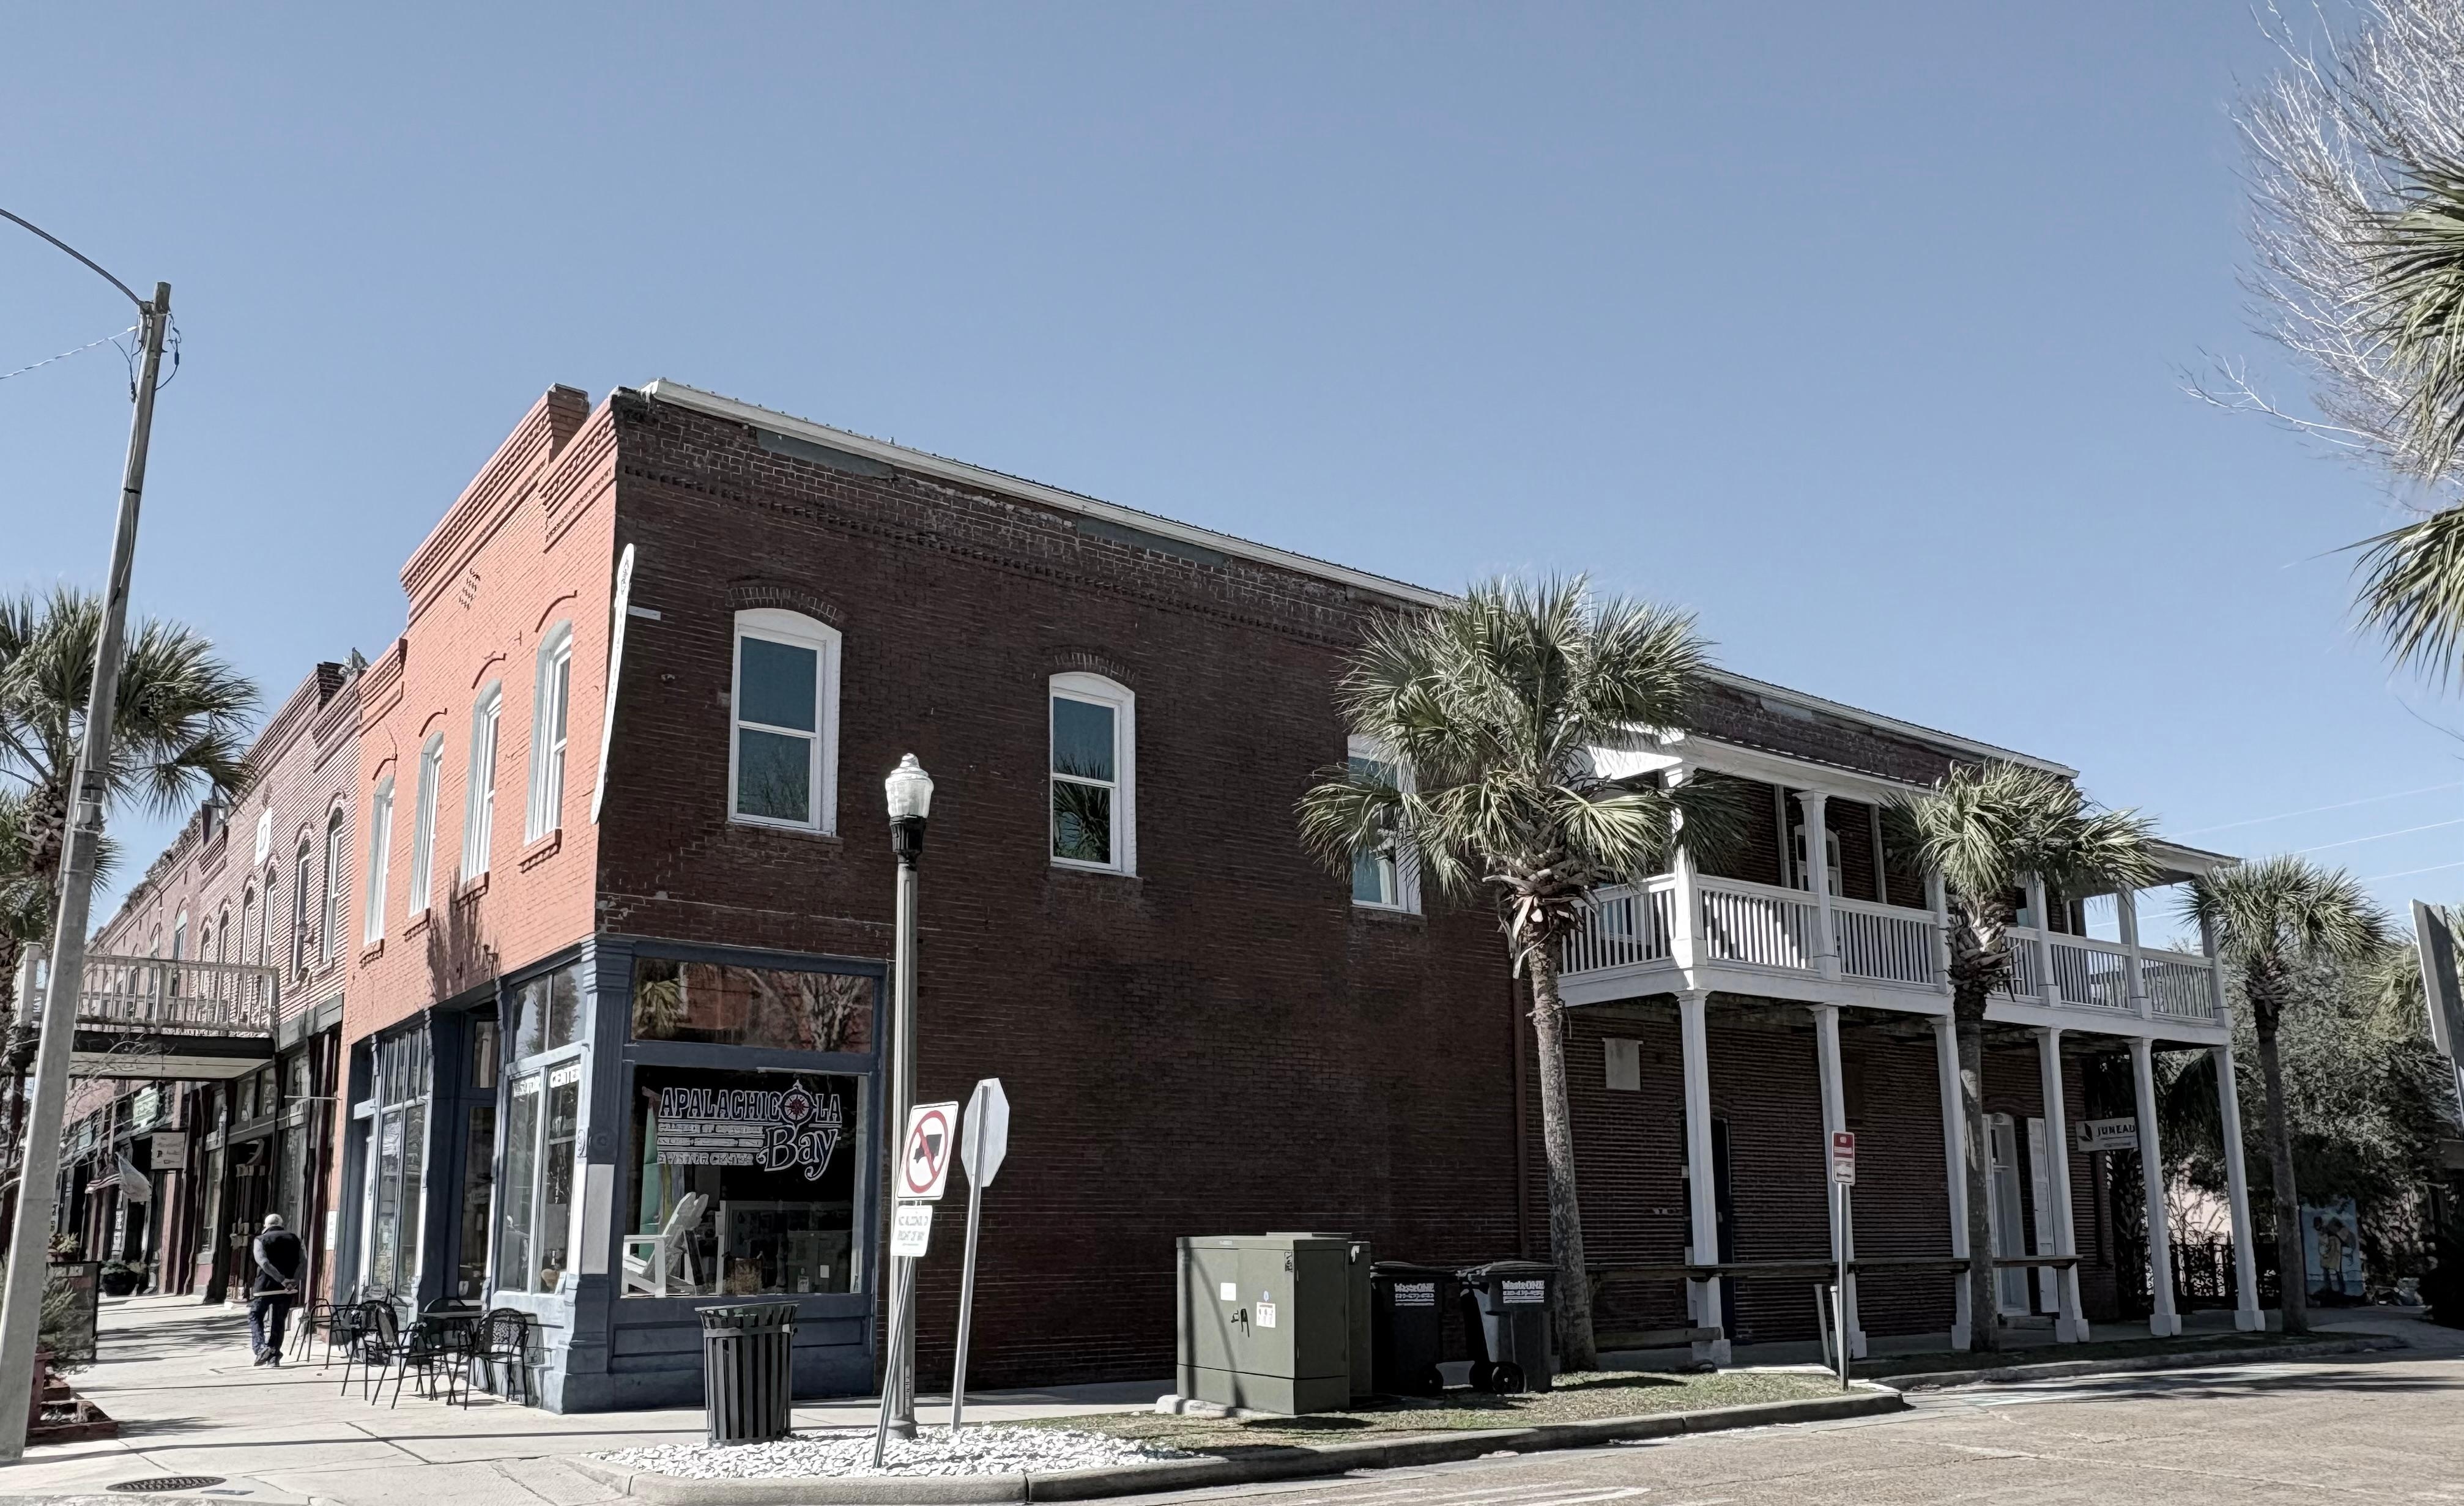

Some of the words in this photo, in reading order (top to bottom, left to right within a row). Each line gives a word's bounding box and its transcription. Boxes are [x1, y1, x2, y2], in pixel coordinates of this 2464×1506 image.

[551, 1065, 581, 1088] CENTE
[658, 1081, 843, 1124] APALACHICOLA
[756, 1124, 839, 1181] Bay
